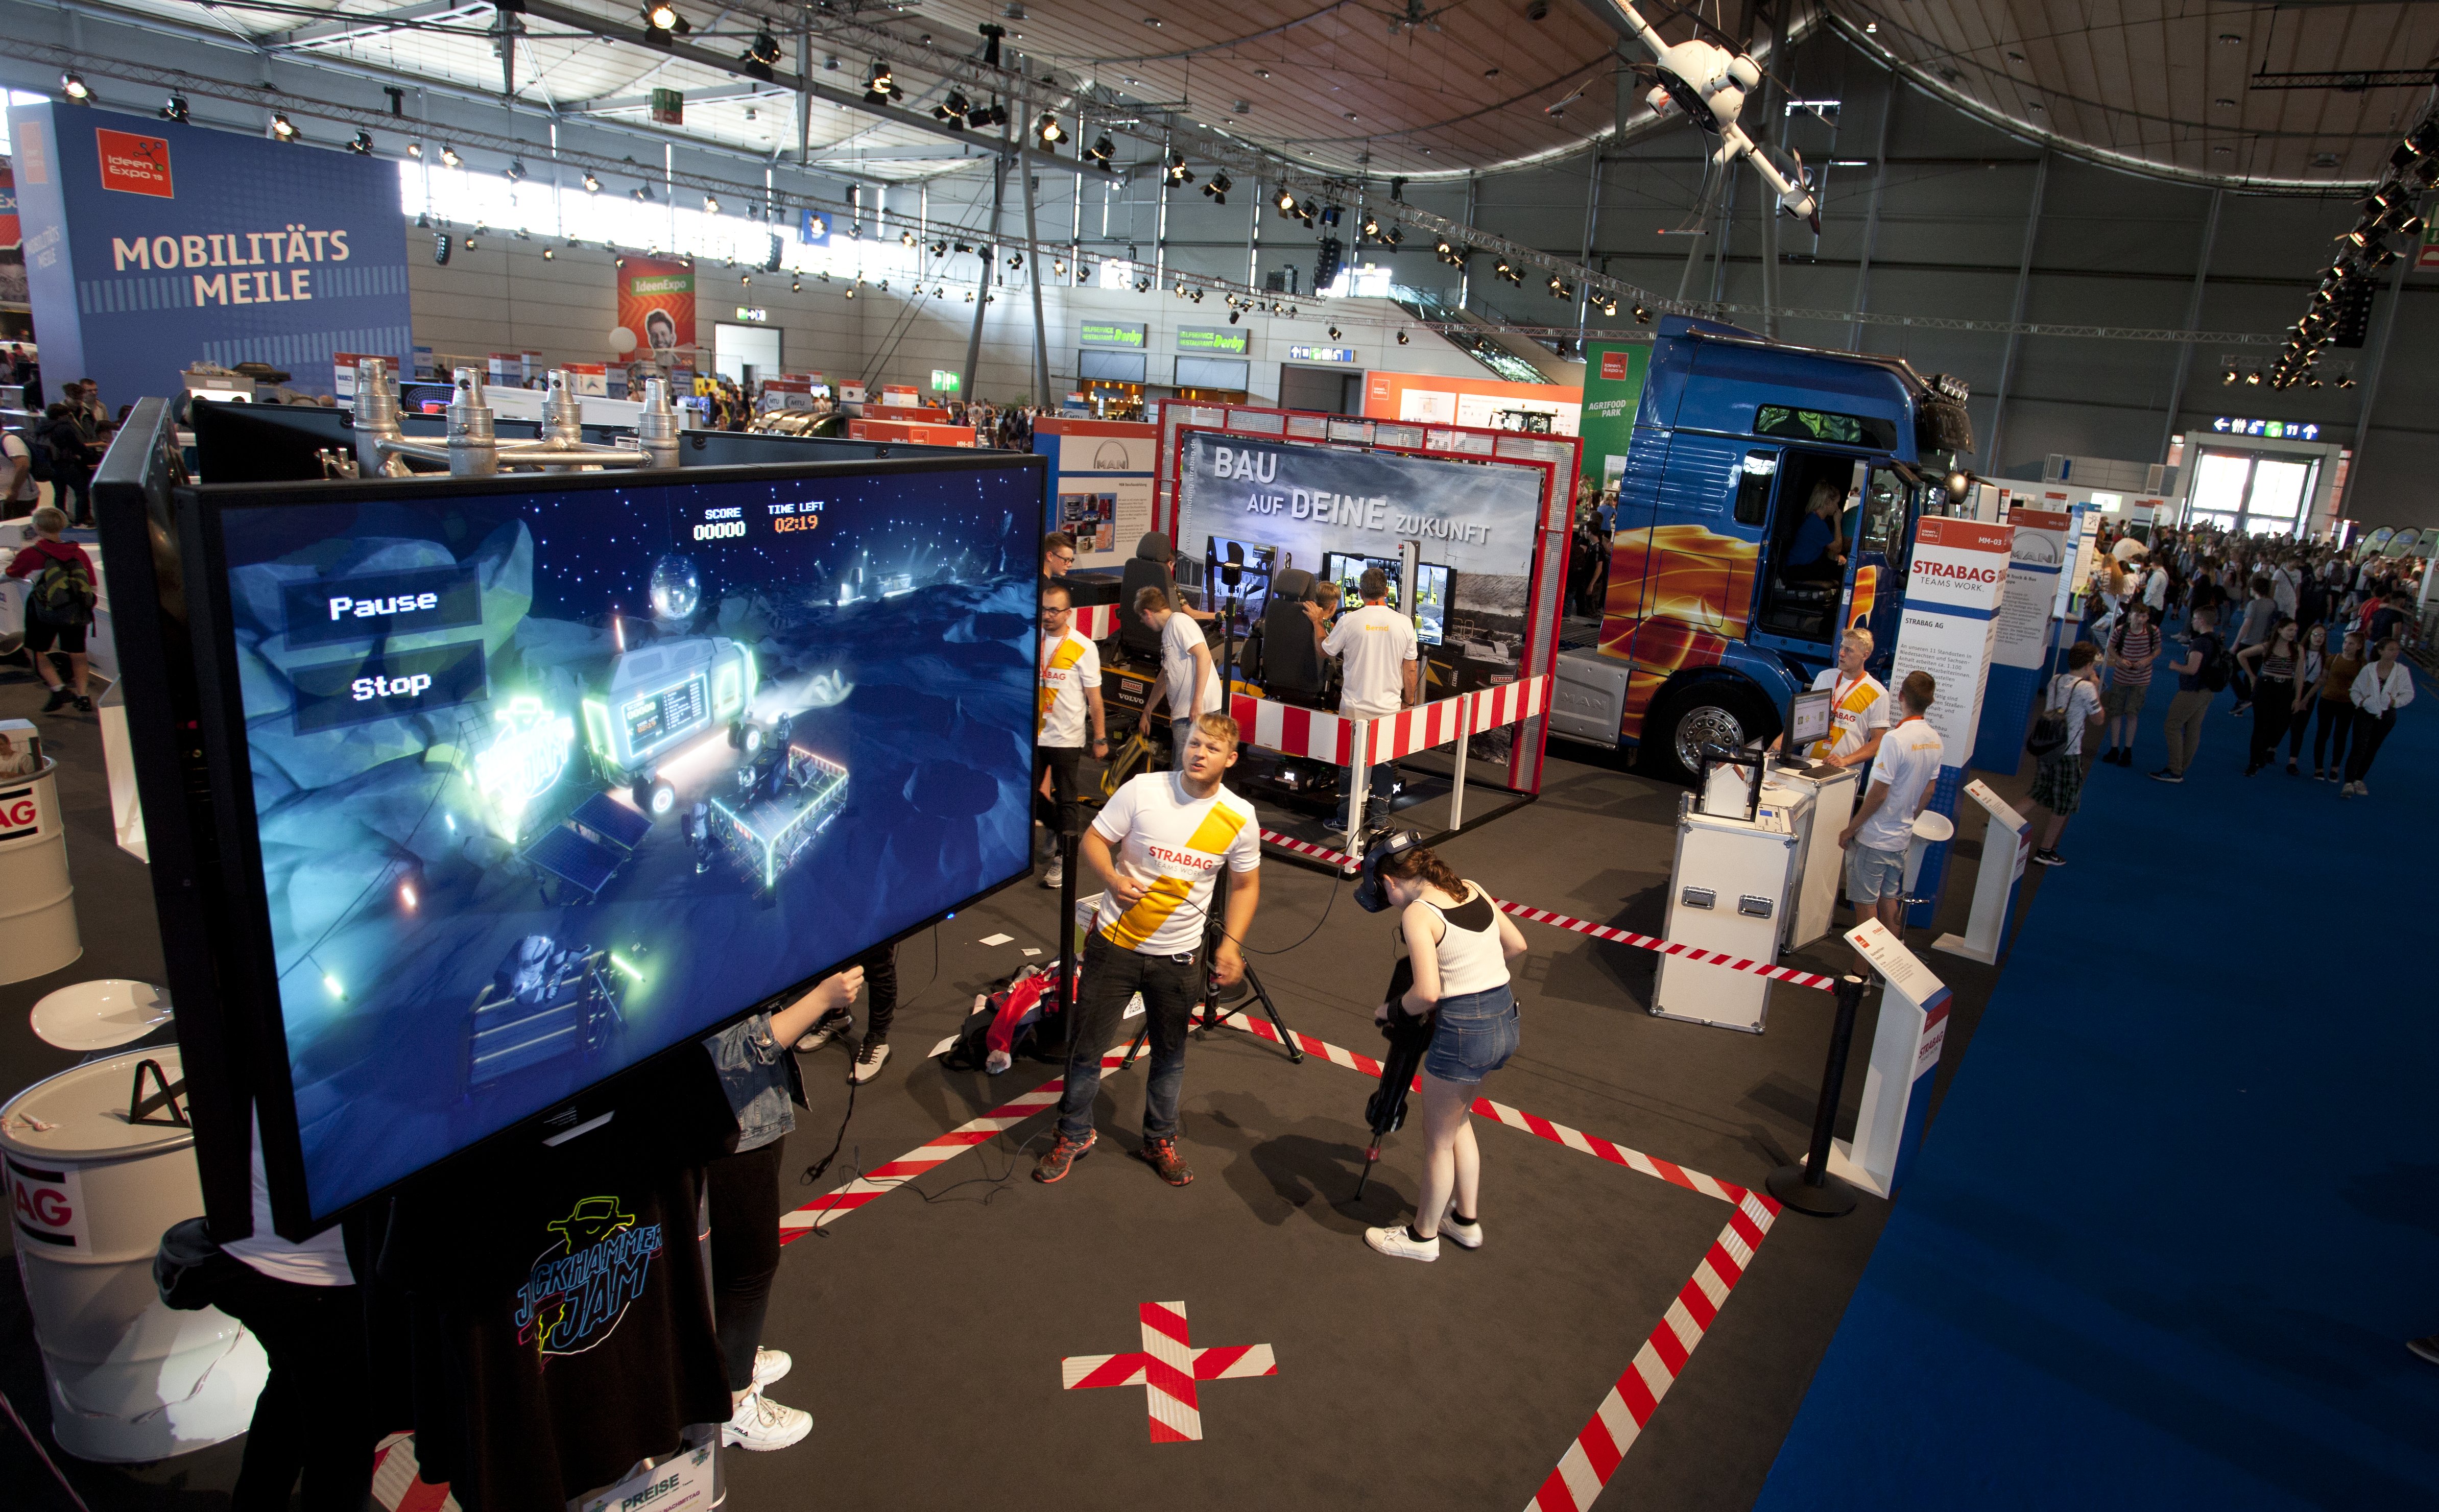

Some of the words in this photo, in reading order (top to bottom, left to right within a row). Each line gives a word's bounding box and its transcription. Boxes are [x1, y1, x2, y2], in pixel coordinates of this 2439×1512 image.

[107, 155, 153, 170] Ideen
[109, 165, 151, 179] Expo
[153, 173, 164, 181] 19
[112, 224, 350, 271] MOBILITÄTS
[194, 269, 312, 306] MEILE
[635, 279, 687, 292] IdeenExpo
[1114, 328, 1143, 347] Derby
[1213, 334, 1246, 353] Derby
[1588, 400, 1627, 411] AGRIFOOD
[1602, 409, 1621, 418] PARK
[2286, 425, 2299, 436] 11
[1096, 460, 1127, 469] MAN
[1214, 446, 1277, 484] BAU
[1185, 438, 1197, 551] www.ausbildung.strabag.de
[705, 507, 742, 520] SCORE
[768, 504, 795, 515] TIME
[799, 501, 824, 512] LEFT
[774, 515, 818, 533] 02:19
[1247, 493, 1284, 515] AUF
[1291, 489, 1387, 531] DEINE
[1394, 514, 1491, 544] ZUKUNFT
[694, 520, 746, 541] 00000
[1978, 537, 2002, 546] MM-03
[2011, 550, 2054, 563] MAN
[1912, 560, 1996, 583] STRABAG
[1921, 577, 1951, 588] TEAMS
[1954, 581, 1984, 593] WORK.
[330, 592, 438, 621] Pause
[1905, 617, 1933, 628] STRABAG
[1900, 650, 1935, 659] Niedersachsen
[1938, 649, 1966, 658] Standorten
[1927, 667, 1972, 679] Mitarbeiterinnen.
[352, 673, 432, 702] Stop
[1123, 682, 1142, 691] STRABAG
[1118, 693, 1144, 704] VOLVO
[1561, 692, 1607, 710] MAN
[1944, 701, 1966, 709] Straßen-
[1149, 846, 1213, 870] STRABAG
[1155, 860, 1178, 872] TEAMS
[1918, 1030, 1944, 1060] STRABAG
[553, 1251, 651, 1349] JAM
[734, 1427, 749, 1437] FILA
[621, 1473, 680, 1512] PREISE
[663, 1490, 701, 1512] NACHMITTAG
